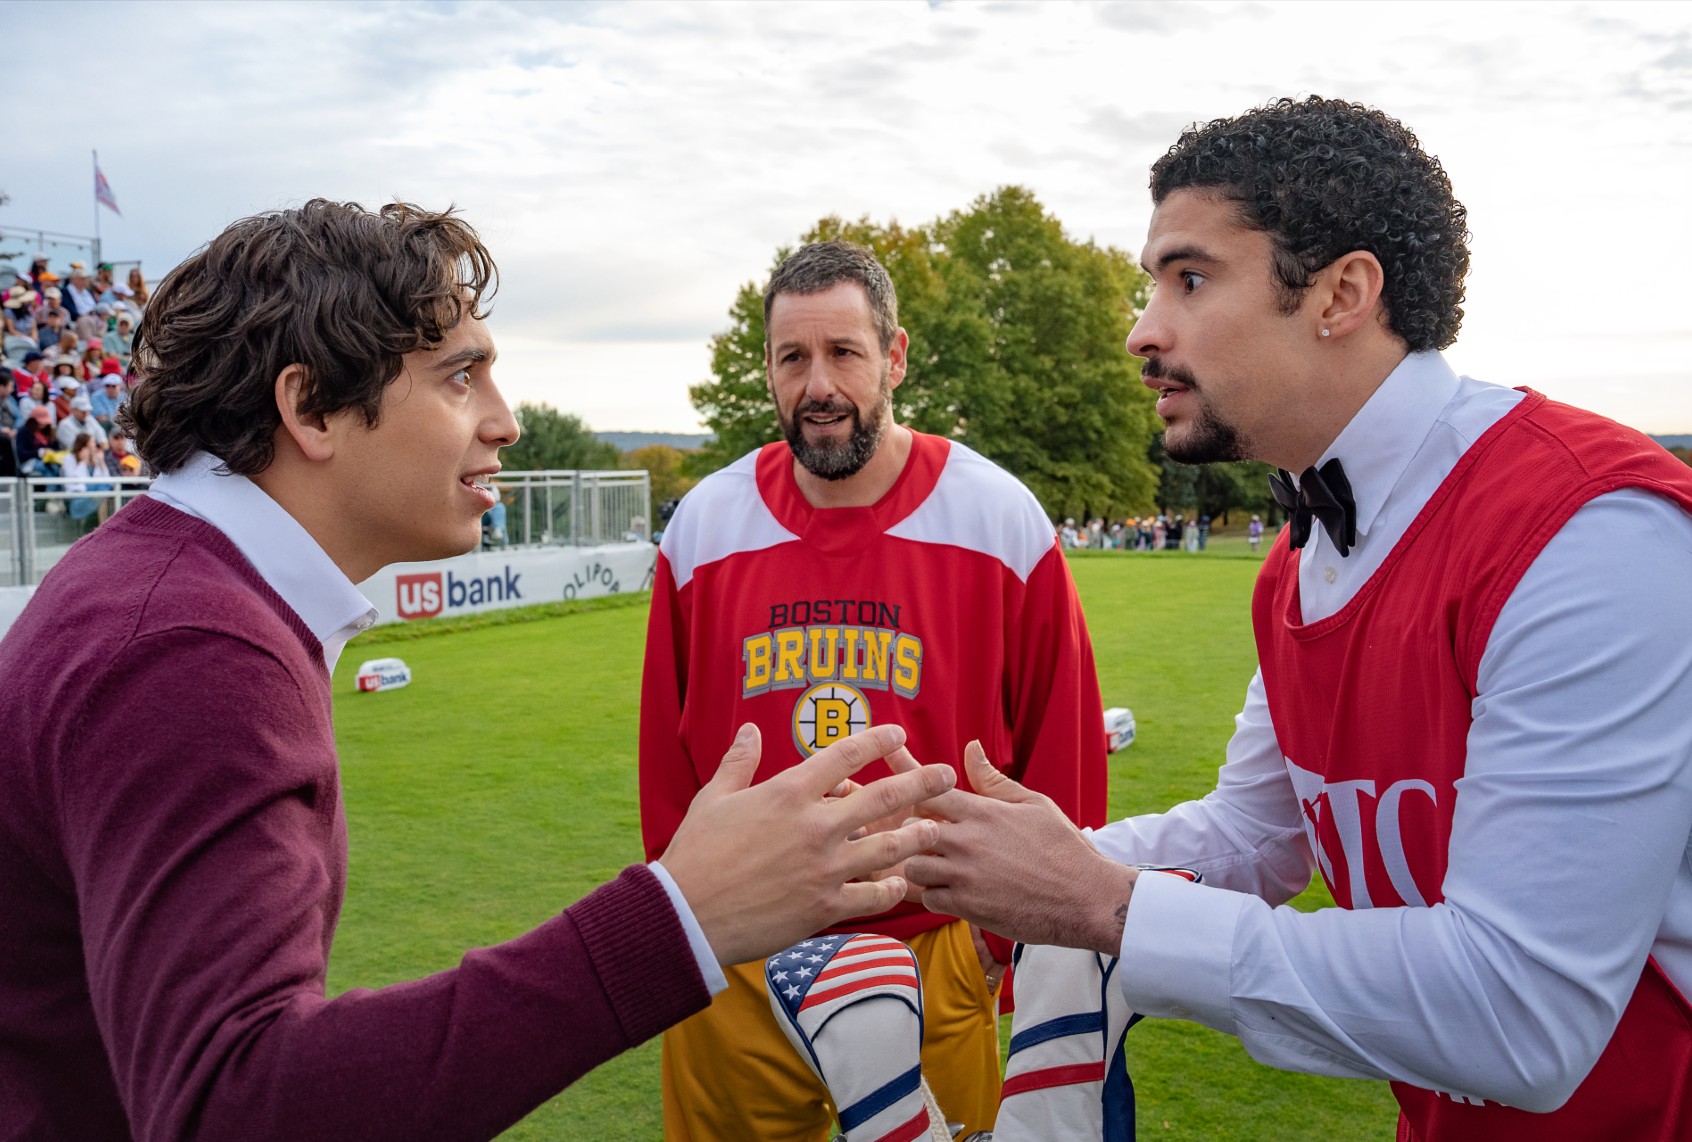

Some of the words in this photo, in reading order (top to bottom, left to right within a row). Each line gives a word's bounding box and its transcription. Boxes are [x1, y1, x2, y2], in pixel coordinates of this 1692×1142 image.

[447, 565, 522, 608] bank
[768, 600, 901, 628] BOSTON
[742, 624, 923, 699] BRUINS
[815, 698, 851, 748] B
